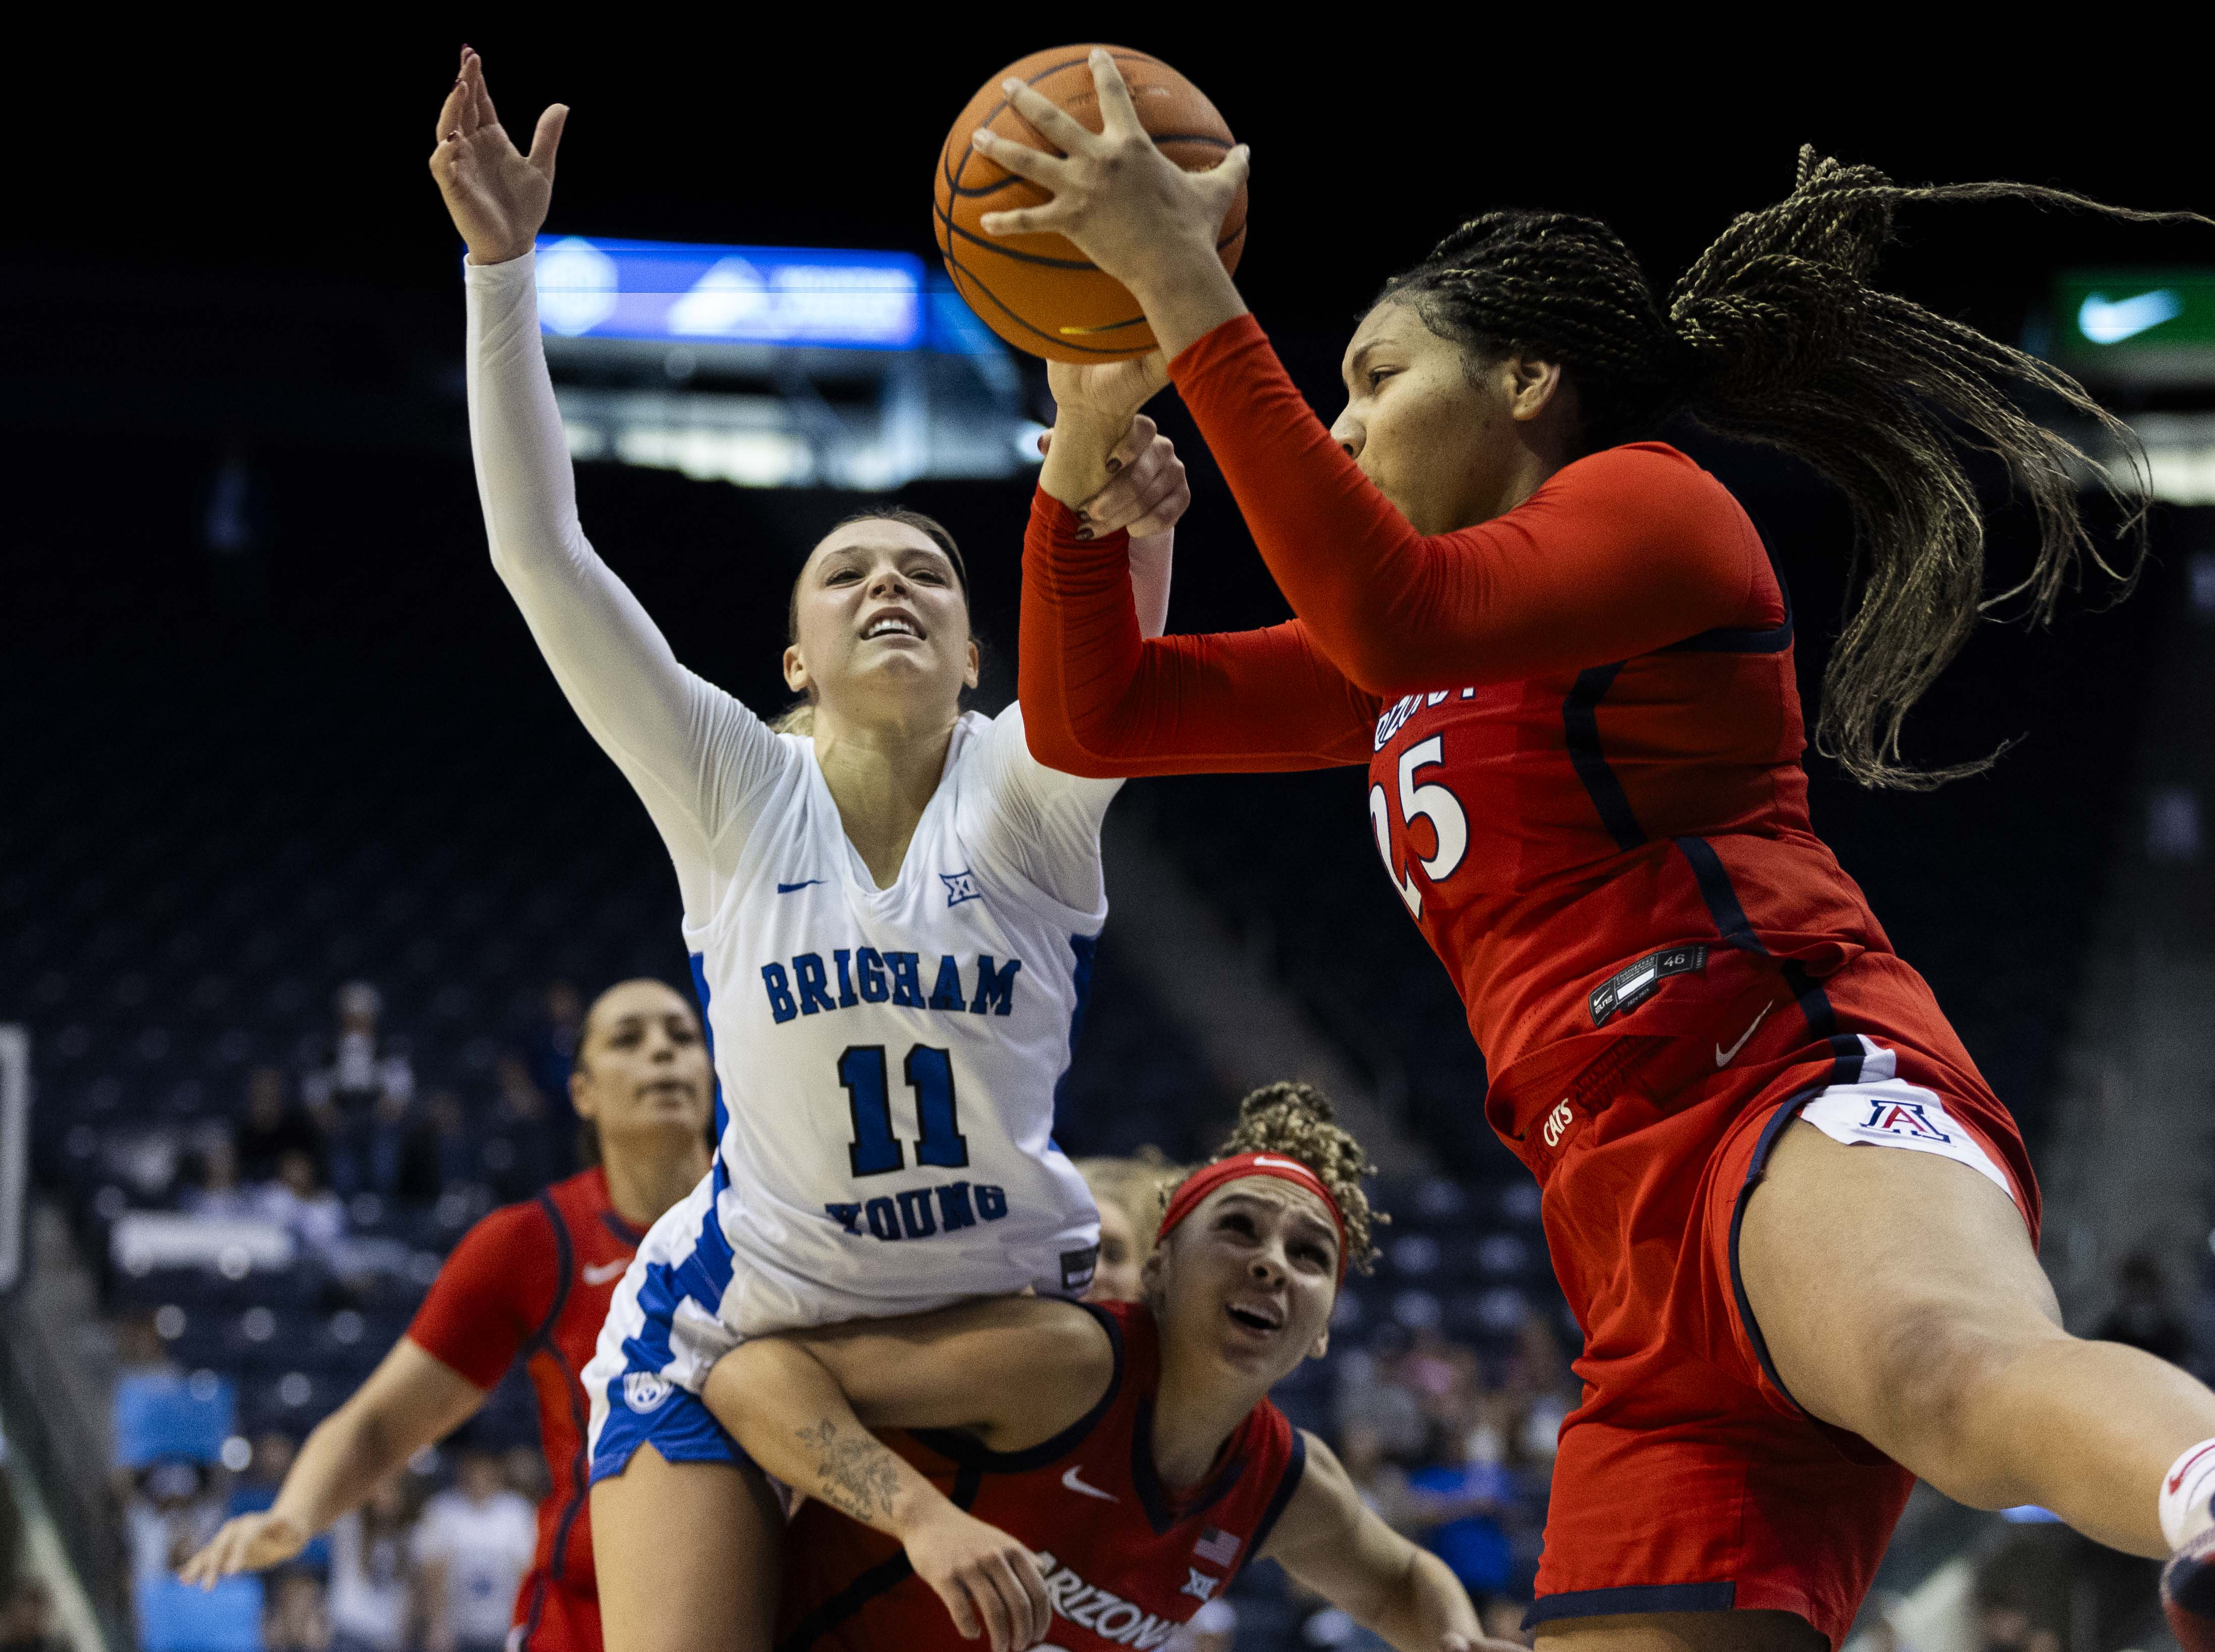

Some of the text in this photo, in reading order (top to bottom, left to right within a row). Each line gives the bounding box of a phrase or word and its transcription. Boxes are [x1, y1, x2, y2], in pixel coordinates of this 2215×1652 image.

[1369, 732, 1470, 923] 25
[761, 946, 1021, 1024] BRIGHAM
[1664, 954, 1685, 966] 46
[837, 1043, 970, 1178] 11
[1543, 1098, 1573, 1147] CATS
[825, 1180, 1008, 1241] YOUNG
